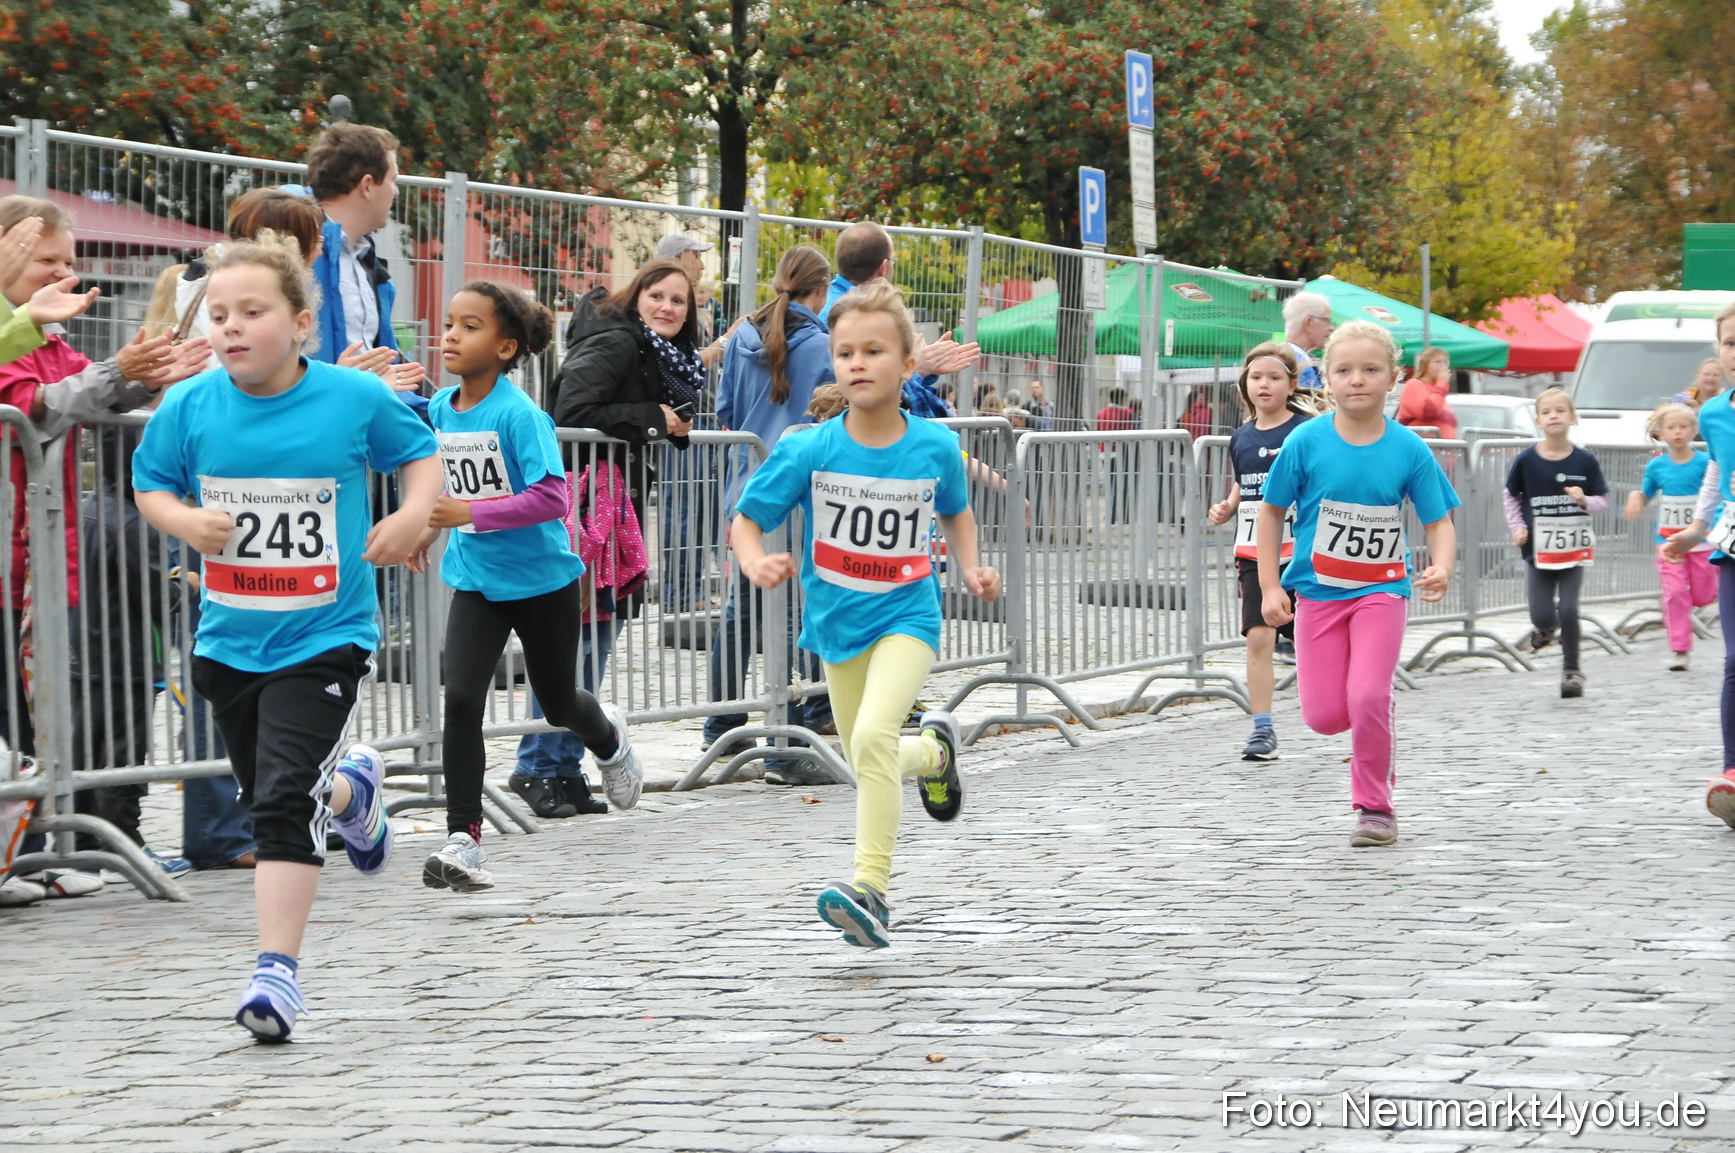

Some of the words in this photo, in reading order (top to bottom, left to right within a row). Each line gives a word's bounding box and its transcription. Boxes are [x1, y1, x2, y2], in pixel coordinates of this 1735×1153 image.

[1132, 62, 1147, 116] P
[1085, 178, 1100, 234] P
[444, 443, 485, 453] Neumarkt
[441, 457, 503, 494] 504
[202, 488, 239, 504] PARTL
[242, 492, 311, 504] Neumarkt
[815, 481, 856, 498] PARTL
[859, 488, 919, 502] Neumarkt
[825, 500, 920, 550] 7091
[1322, 506, 1354, 520] PARTL
[217, 510, 324, 559] 243
[1328, 521, 1401, 559] 7557
[1542, 529, 1592, 550] 7516
[842, 555, 898, 579] Sophie
[233, 571, 298, 592] Nadine
